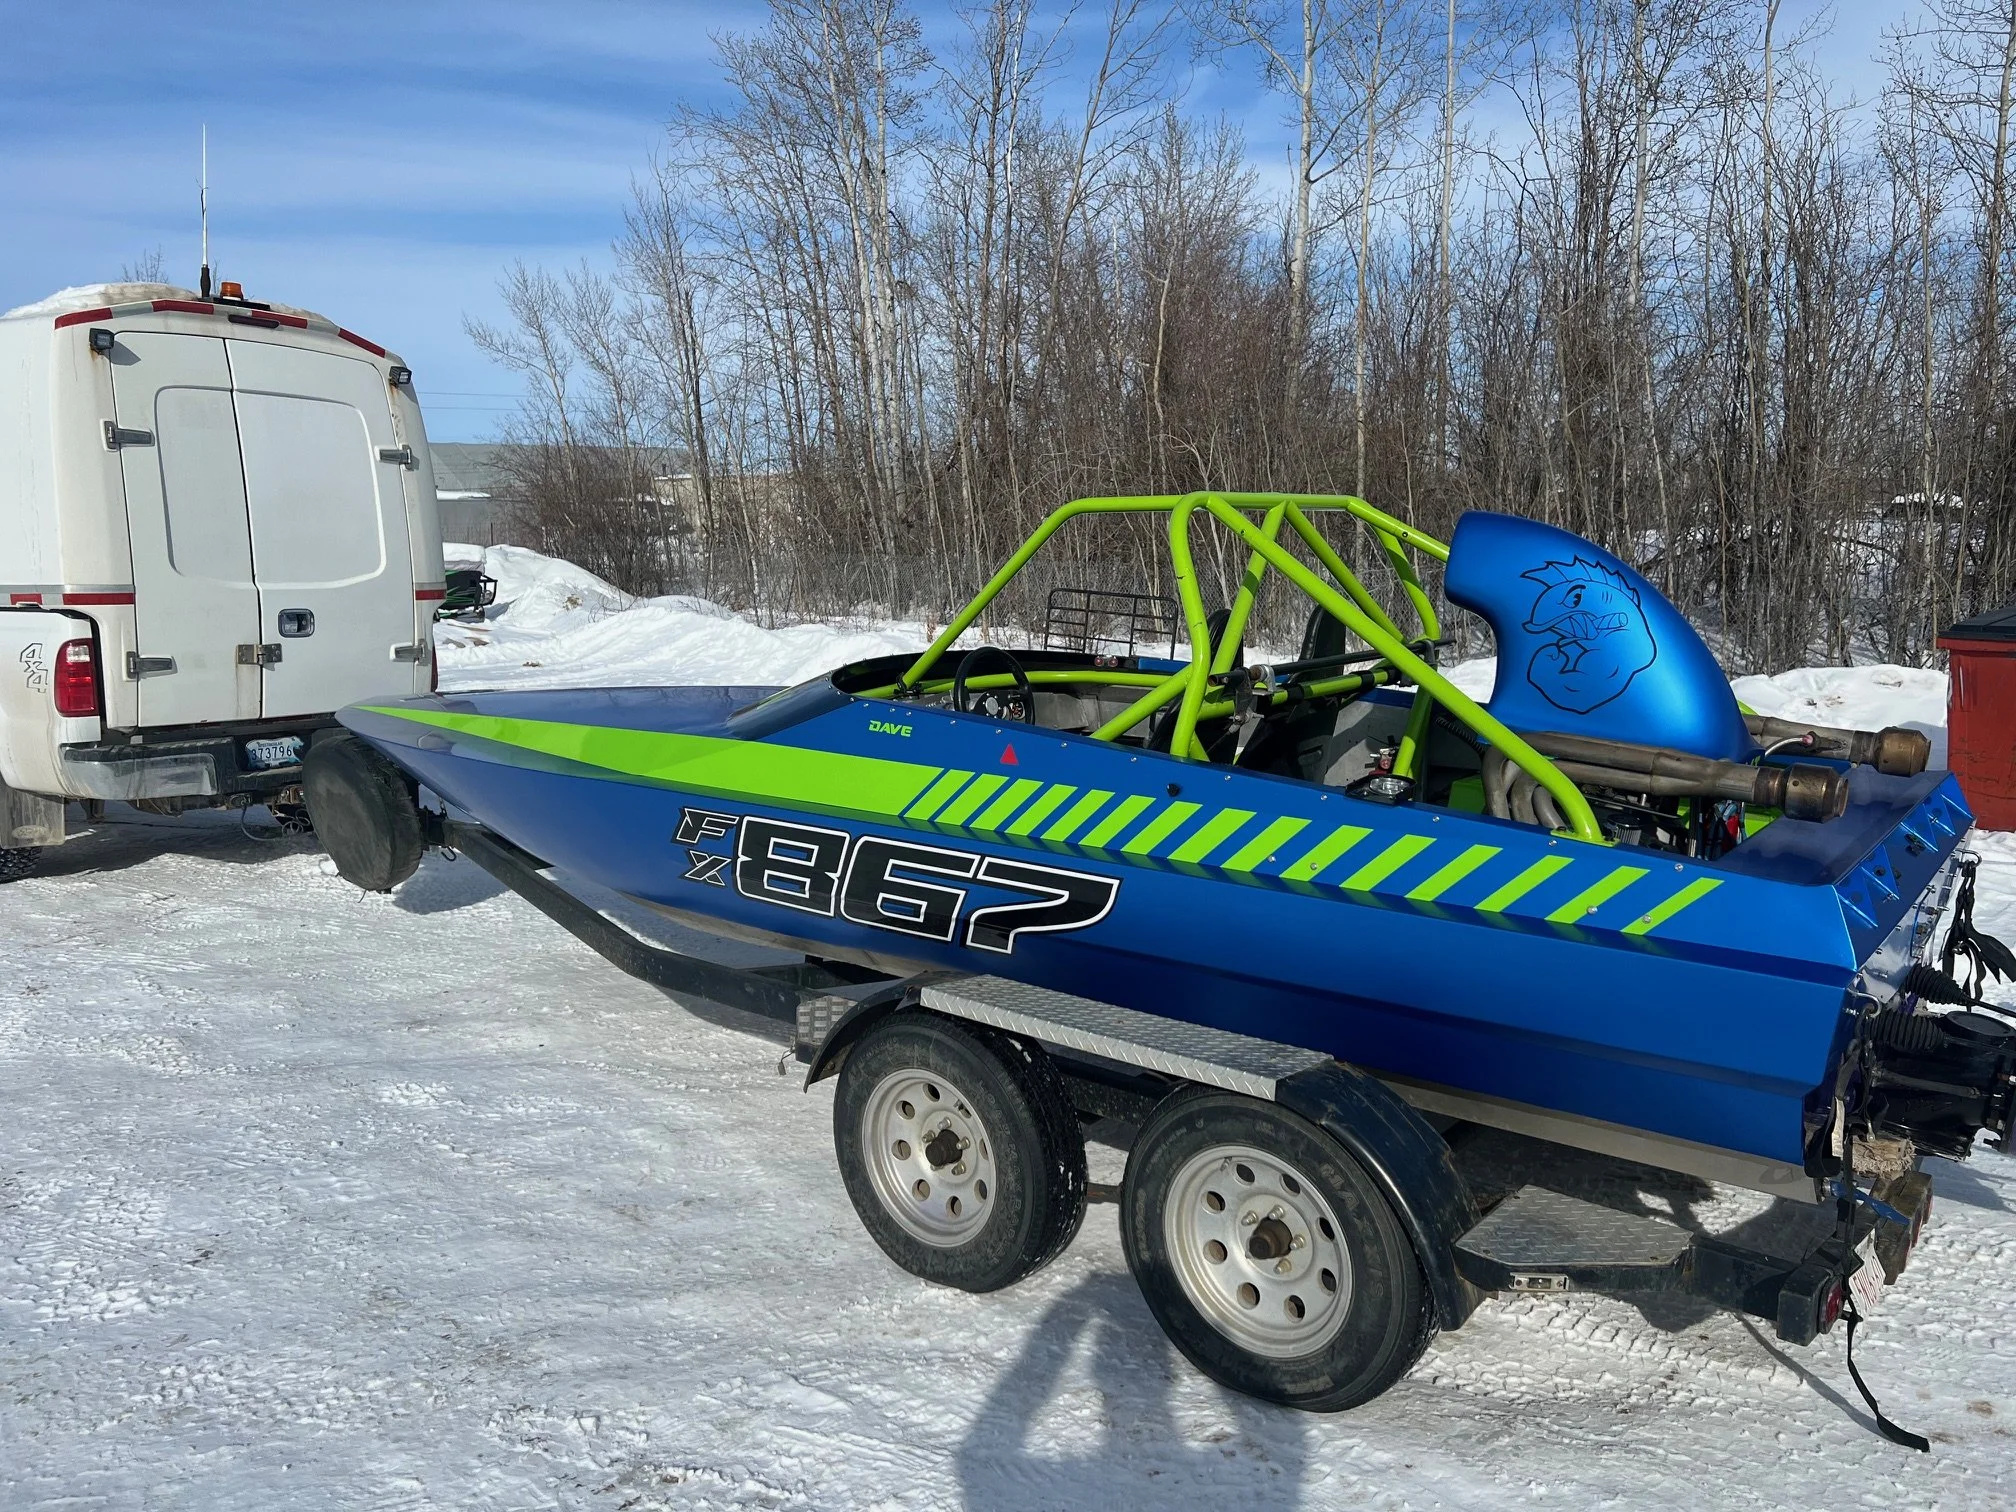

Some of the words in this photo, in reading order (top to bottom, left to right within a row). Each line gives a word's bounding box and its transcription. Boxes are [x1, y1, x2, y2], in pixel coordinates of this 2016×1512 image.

[869, 719, 913, 737] DAVE
[251, 745, 292, 760] 373796
[735, 814, 1123, 955] 867
